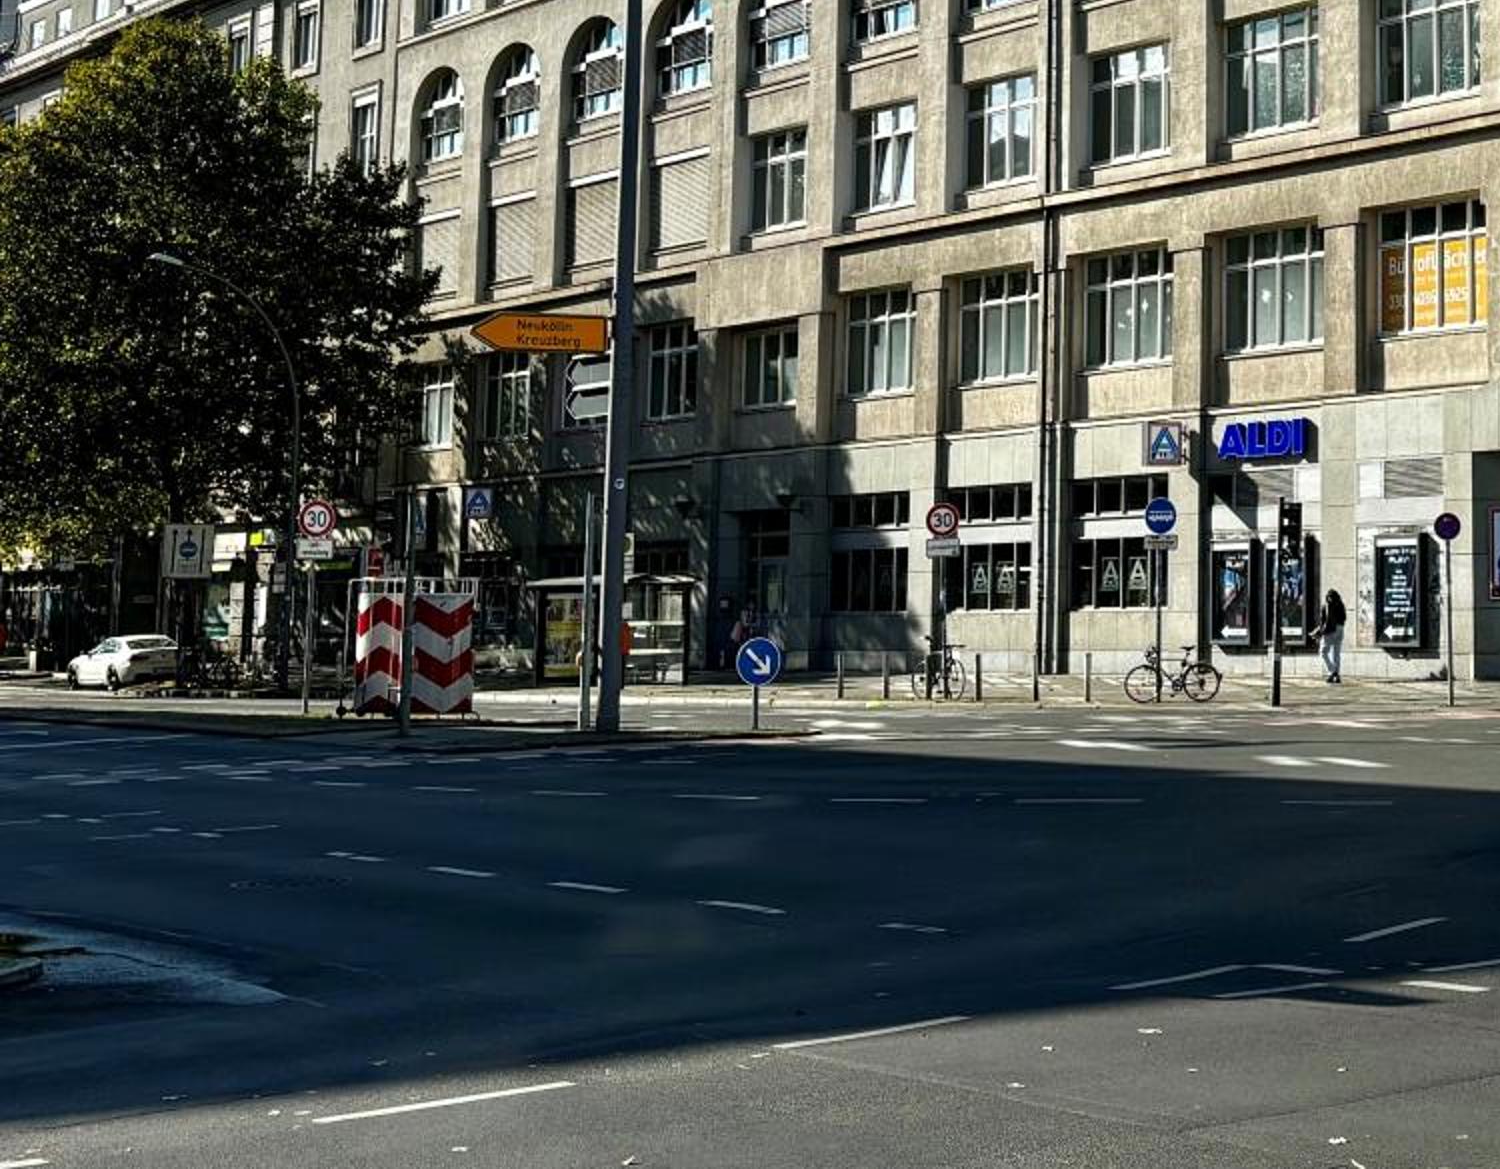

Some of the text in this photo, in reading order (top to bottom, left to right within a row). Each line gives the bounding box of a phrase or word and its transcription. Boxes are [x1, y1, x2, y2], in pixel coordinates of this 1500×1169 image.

[517, 334, 581, 348] Kreuzberg
[1217, 417, 1305, 460] ALDI
[307, 510, 327, 528] 30
[933, 512, 952, 528] 30
